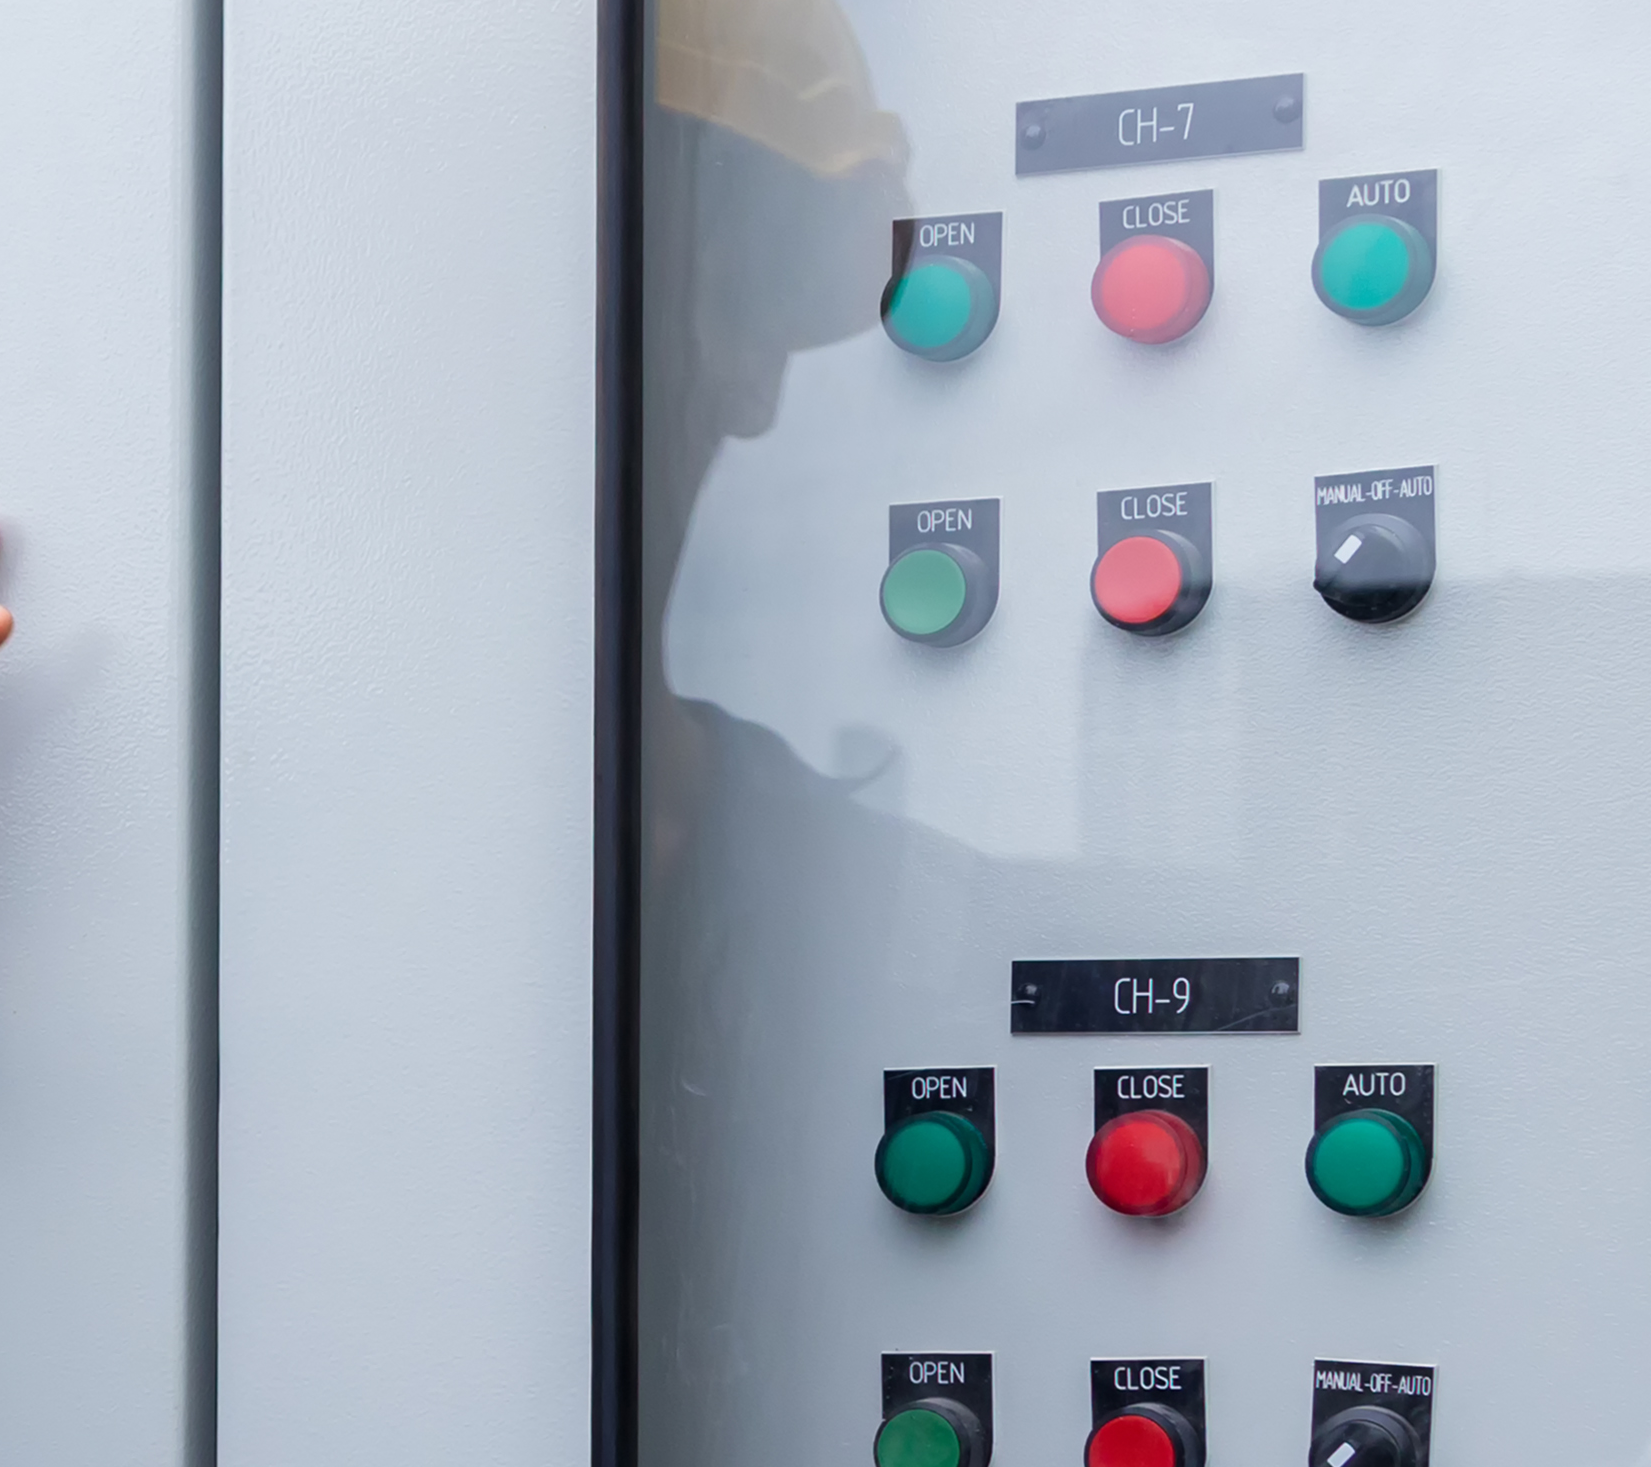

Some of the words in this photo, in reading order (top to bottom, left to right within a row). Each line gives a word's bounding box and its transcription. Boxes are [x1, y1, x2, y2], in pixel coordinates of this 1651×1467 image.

[1118, 102, 1194, 146] CH-7
[1346, 178, 1411, 208] AUTO
[1122, 199, 1191, 229] CLOSE
[919, 222, 975, 248] OPEN
[1316, 475, 1433, 506] MANUAL-OFF-AUTO
[1120, 491, 1188, 520] CLOSE
[917, 508, 973, 533] OPEN
[1114, 977, 1190, 1015] CH-9
[911, 1075, 967, 1100] OPEN
[1117, 1074, 1185, 1099] CLOSE
[1342, 1071, 1406, 1097] AUTO
[909, 1361, 965, 1385] OPEN
[1114, 1365, 1182, 1391] CLOSE
[1315, 1370, 1432, 1397] MANUAL-OFF-AUTO
